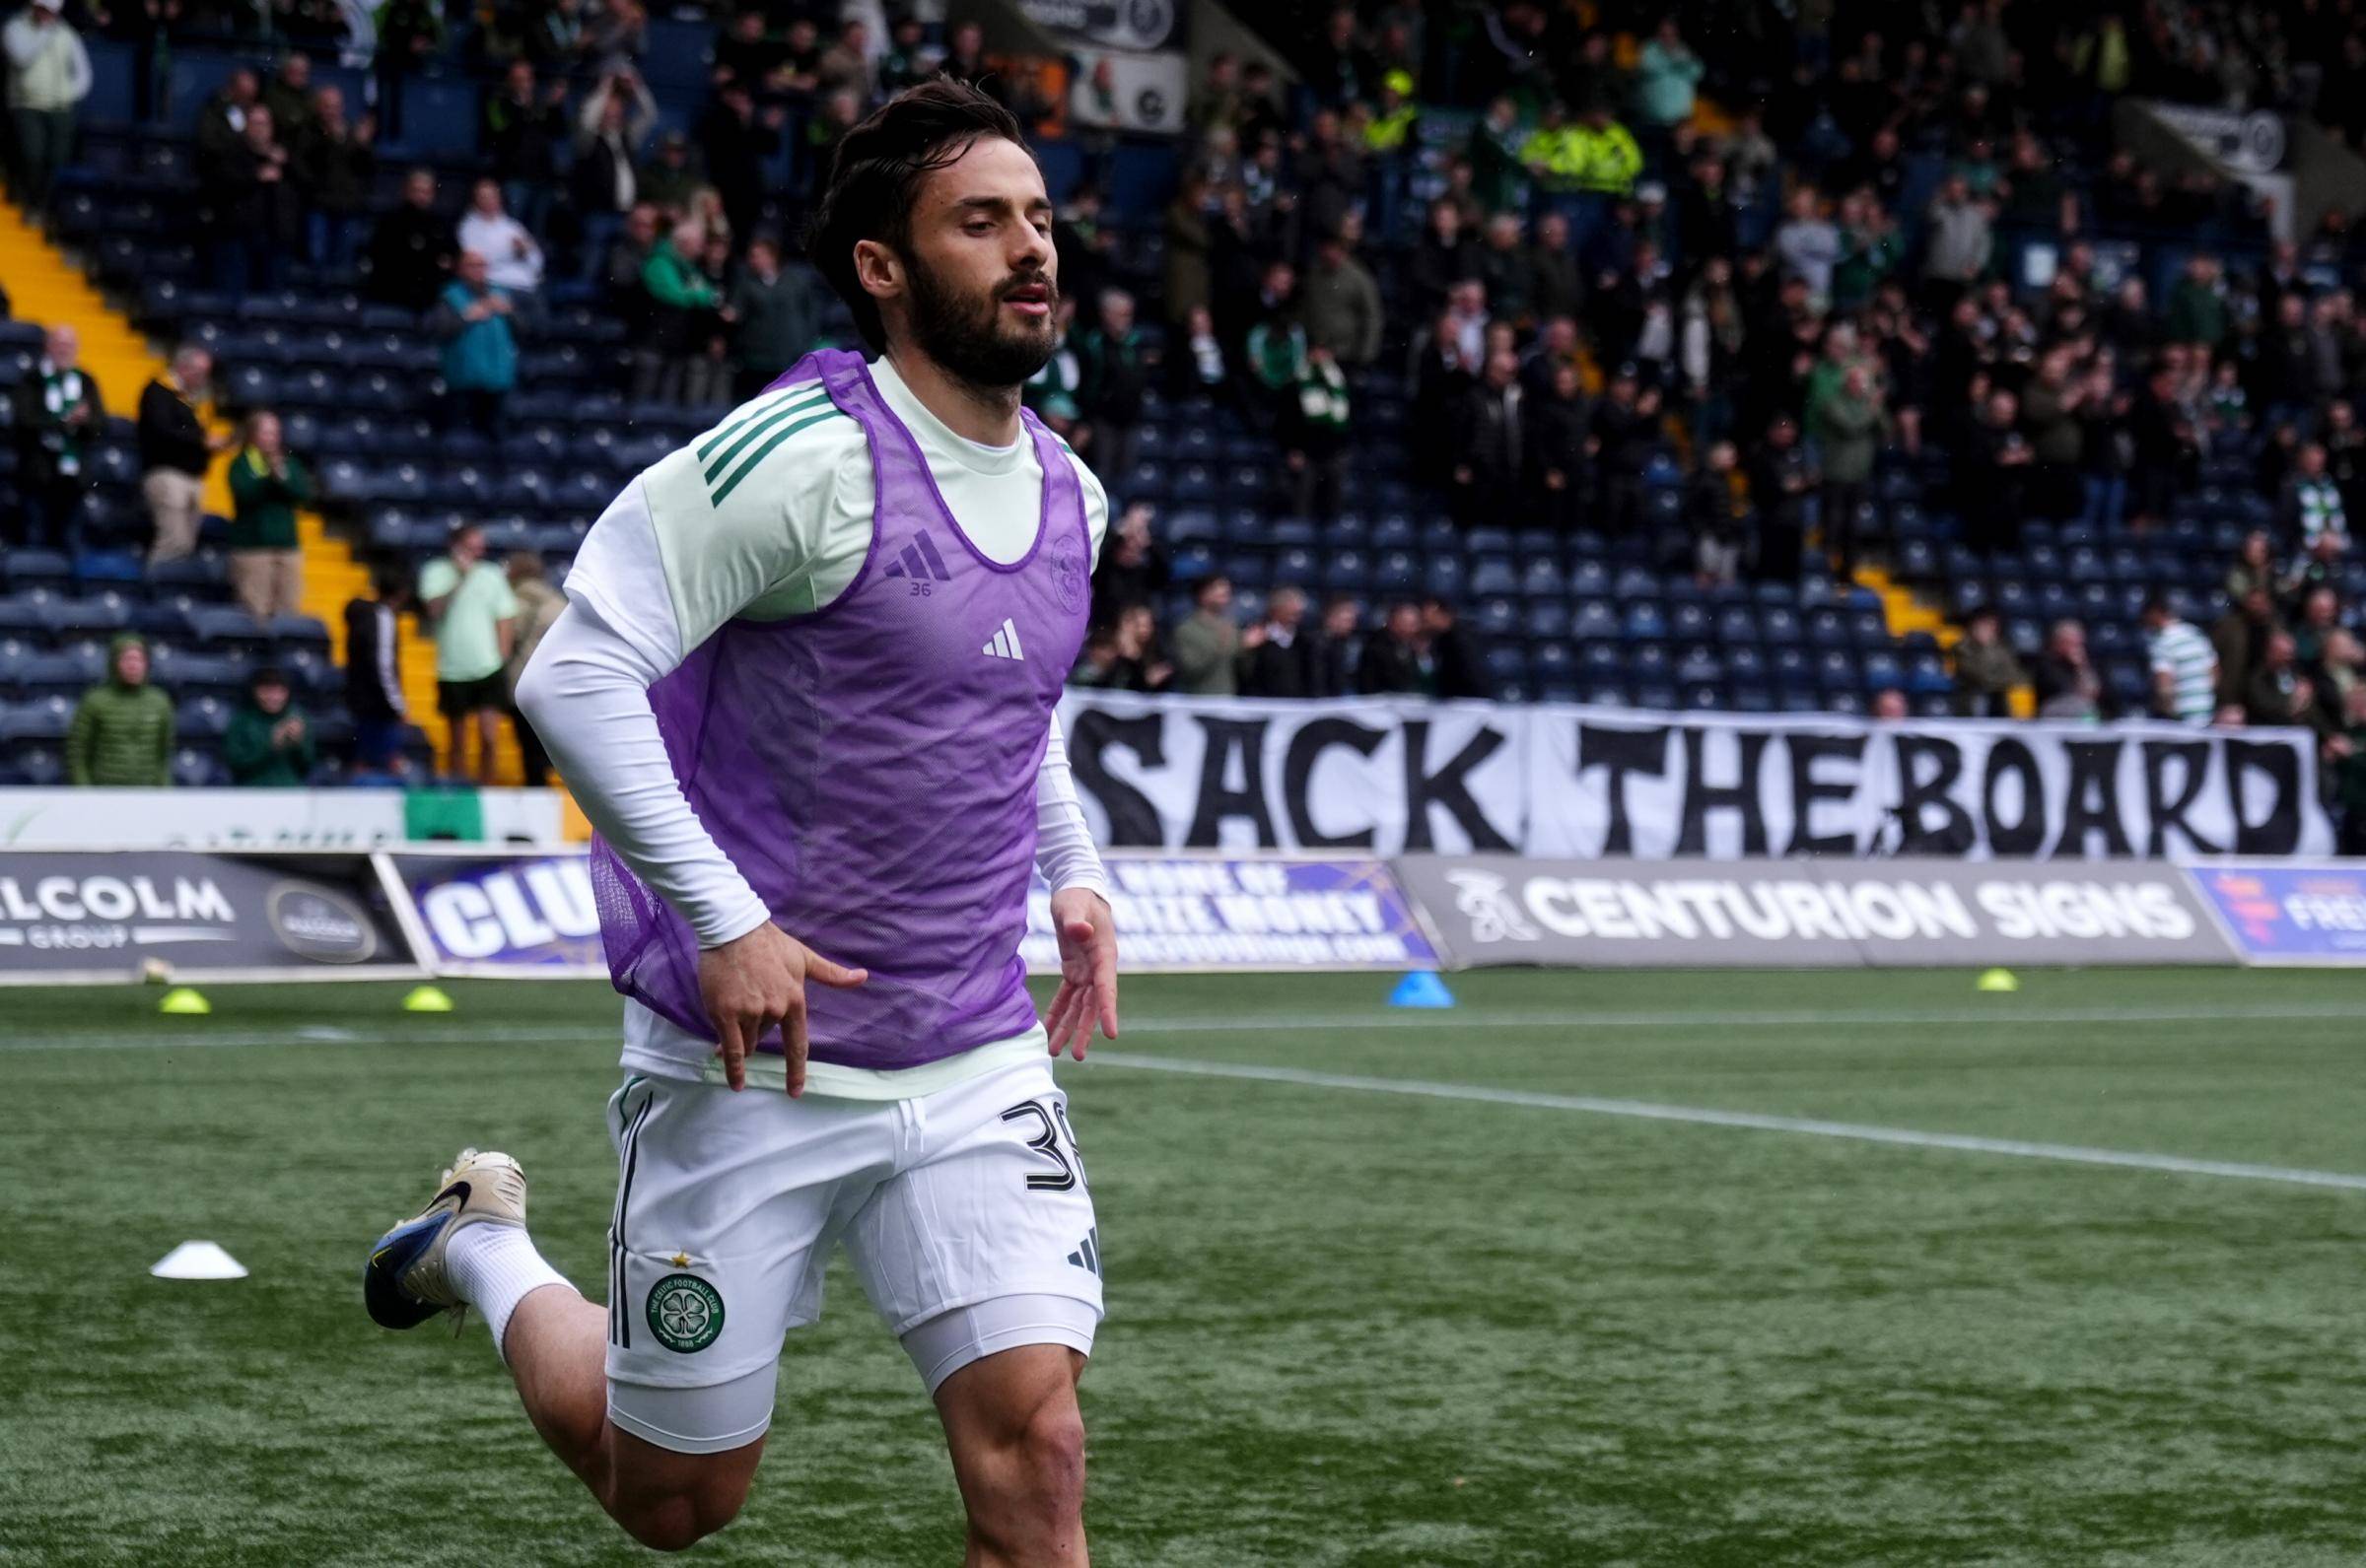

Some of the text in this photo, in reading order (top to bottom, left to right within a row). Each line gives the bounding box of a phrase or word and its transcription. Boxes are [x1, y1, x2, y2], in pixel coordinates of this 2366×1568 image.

[1072, 708, 2302, 857] SACK THE BOARD
[0, 874, 237, 922] LCOLM
[423, 857, 601, 959] CLU
[1522, 875, 2196, 940] CENTURION SIGNS
[26, 923, 129, 949] GROUP
[655, 1281, 674, 1299] CELTIC
[673, 1279, 709, 1298] FOOTBALL
[707, 1294, 720, 1314] CLUB
